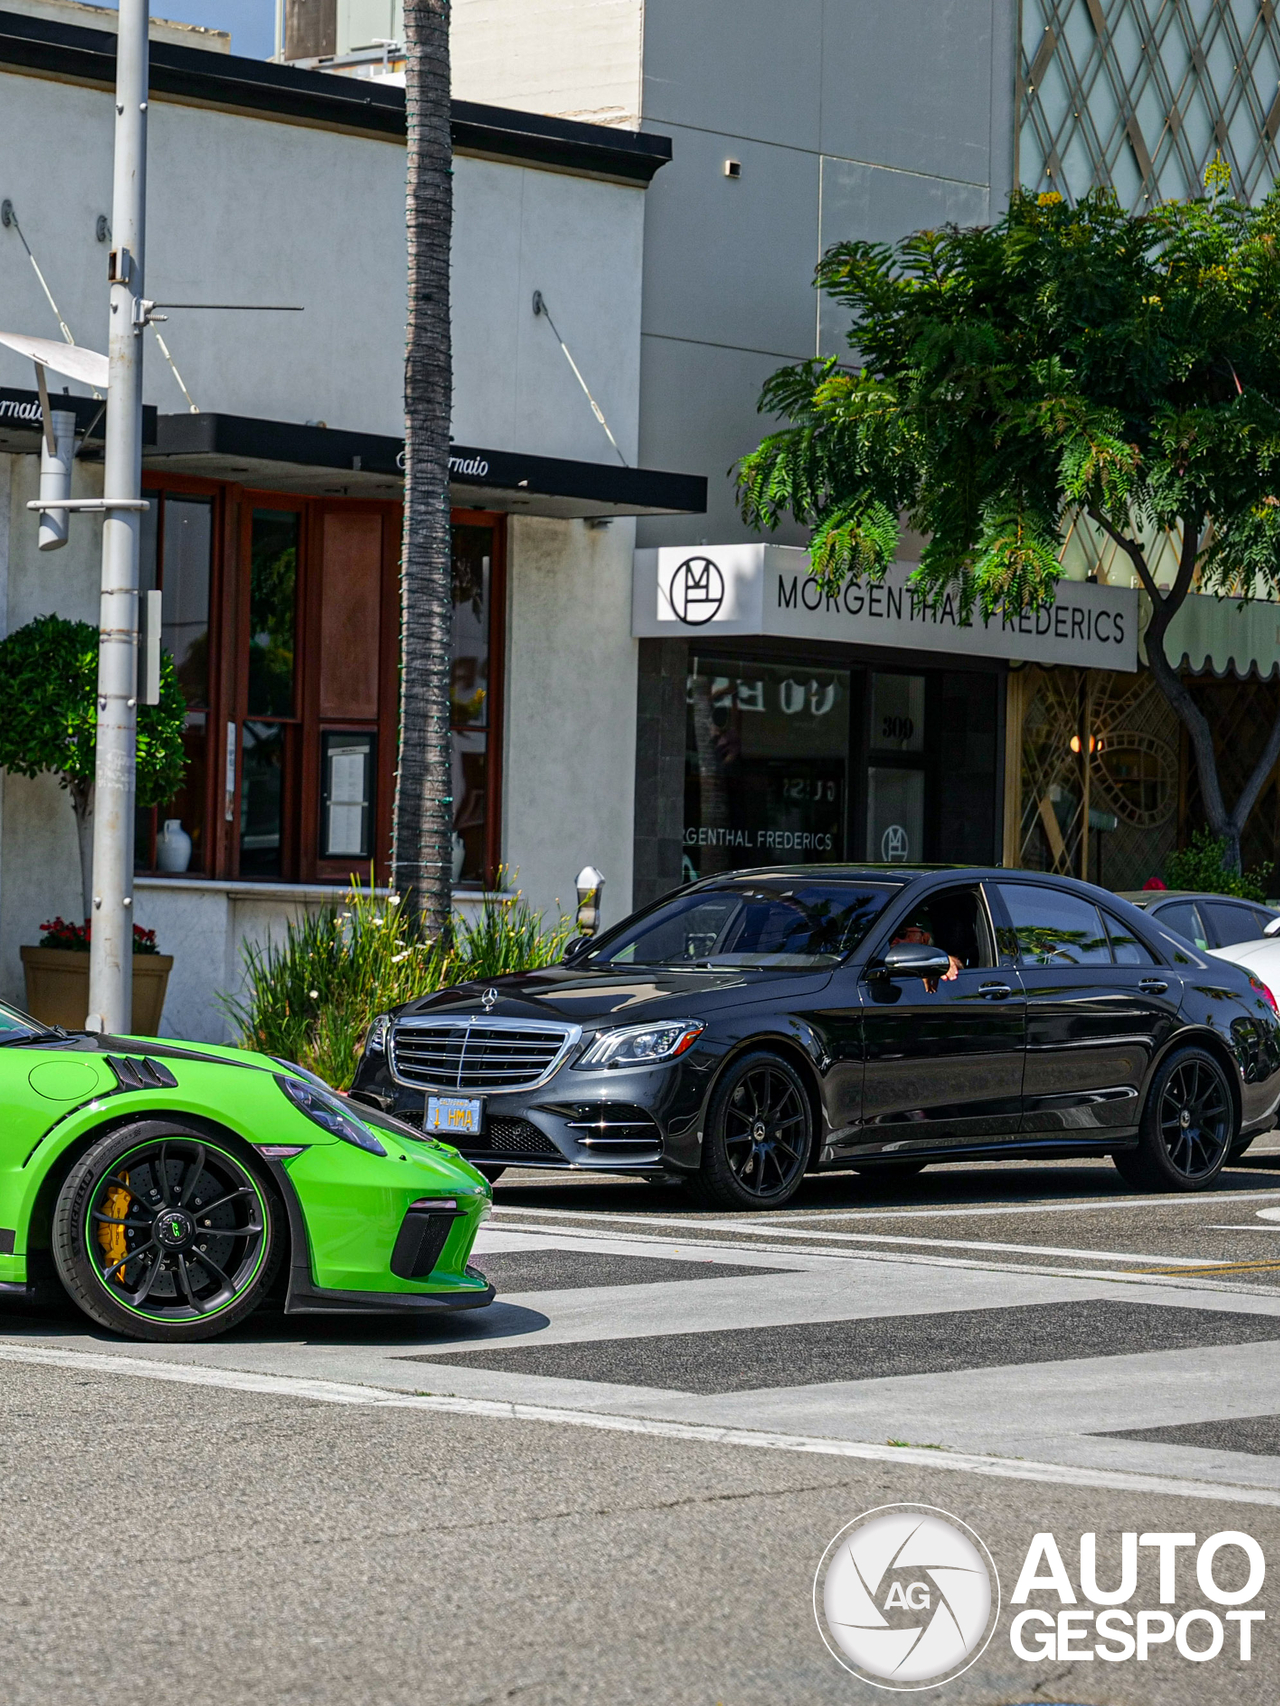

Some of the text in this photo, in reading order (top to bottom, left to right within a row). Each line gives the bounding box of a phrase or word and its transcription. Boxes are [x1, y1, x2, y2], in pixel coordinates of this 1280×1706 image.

[757, 830, 832, 851] FREDERICS
[448, 1109, 473, 1128] HMA
[70, 1170, 93, 1239] MICHELIN
